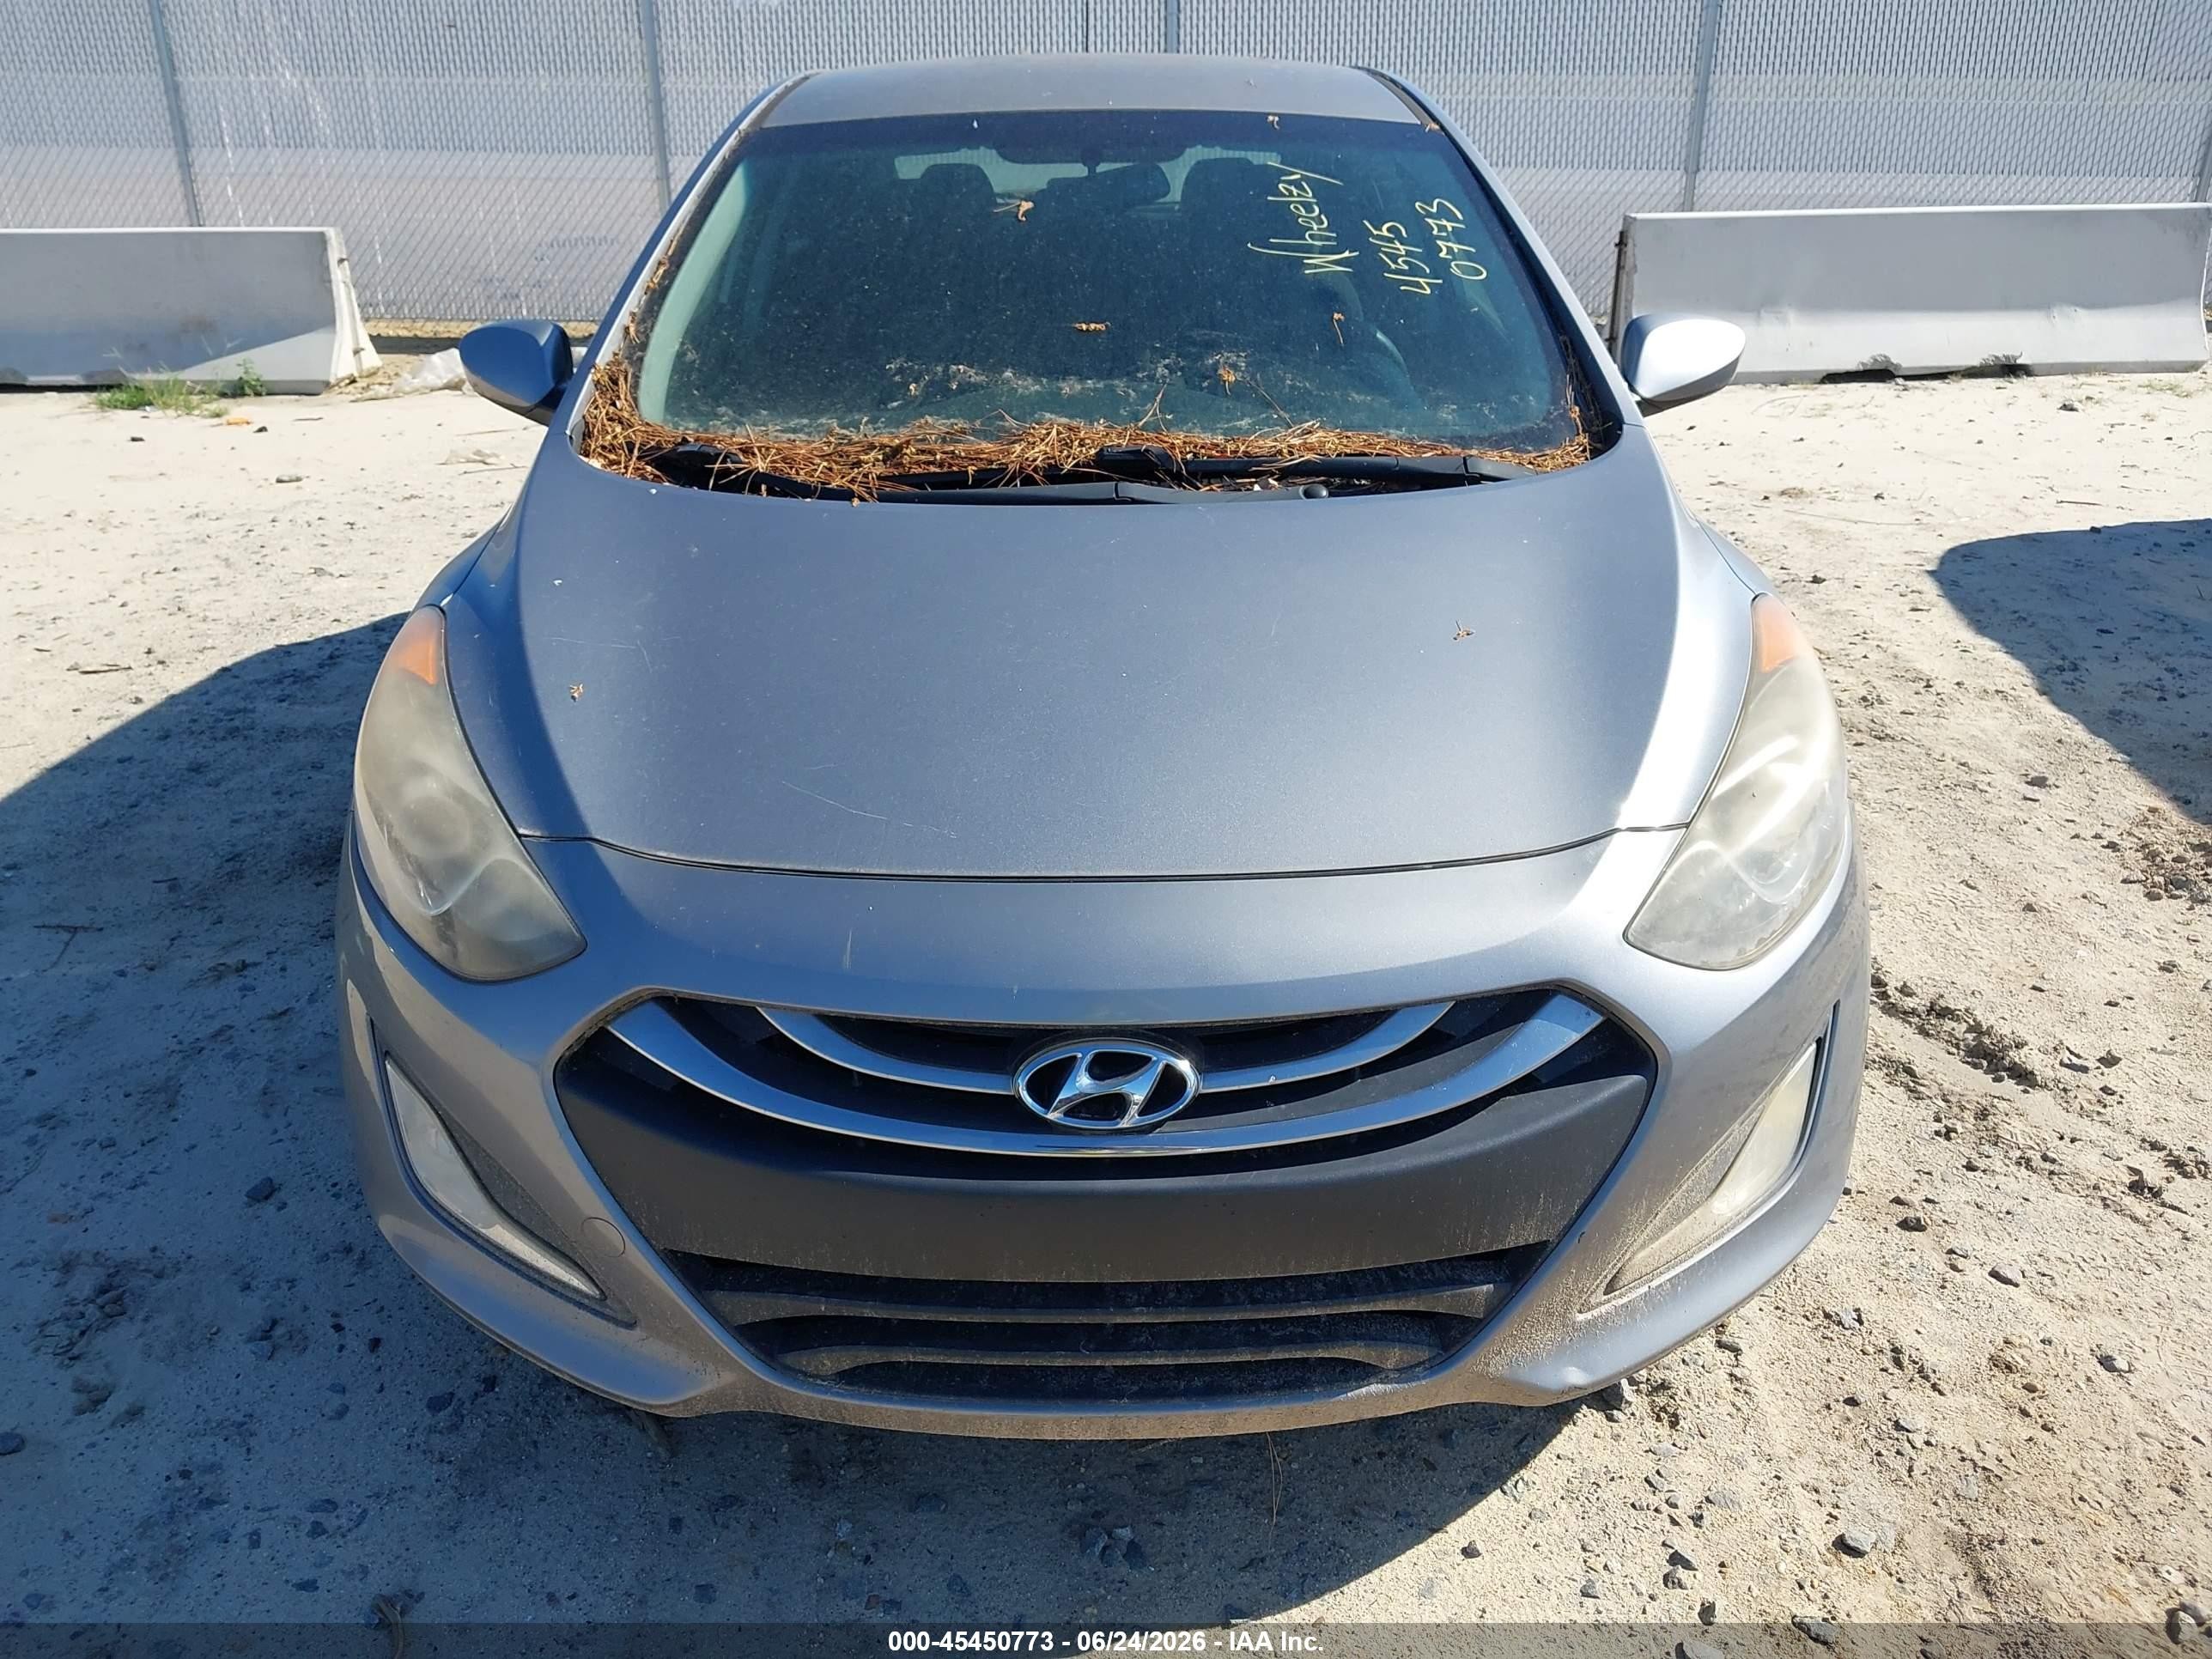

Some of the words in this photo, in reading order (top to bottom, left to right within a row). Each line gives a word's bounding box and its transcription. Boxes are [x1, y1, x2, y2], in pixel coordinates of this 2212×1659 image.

[1247, 161, 1359, 274] Wheelzy
[1364, 220, 1443, 294] 4545
[1415, 198, 1487, 280] 0773
